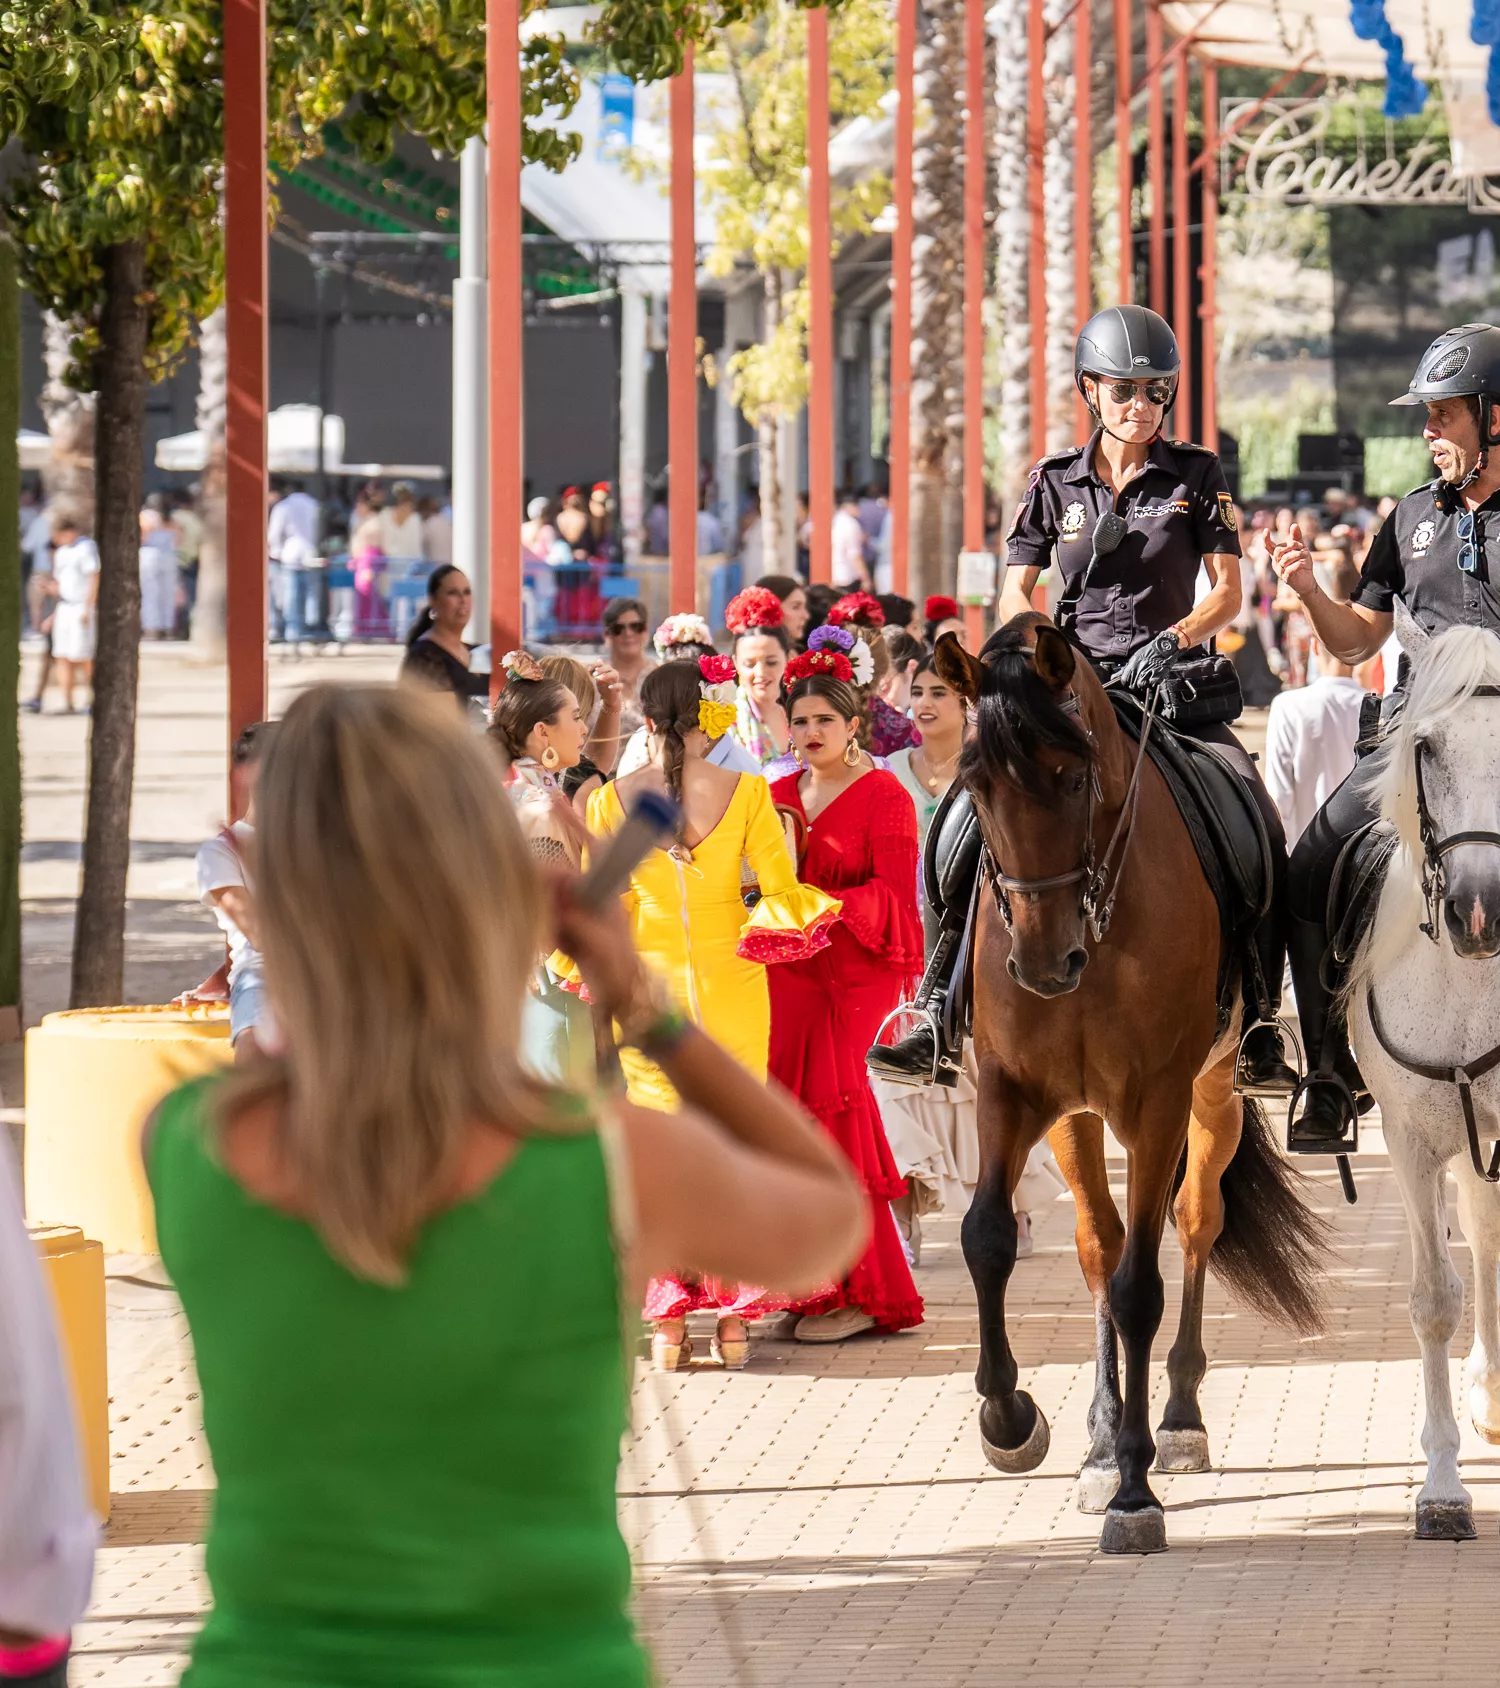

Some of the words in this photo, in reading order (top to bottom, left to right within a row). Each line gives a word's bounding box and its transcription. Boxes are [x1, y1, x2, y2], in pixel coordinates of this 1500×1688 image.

[1224, 99, 1467, 202] Caseta
[1134, 501, 1177, 512] POLICIA
[1134, 506, 1188, 519] NACIONAL
